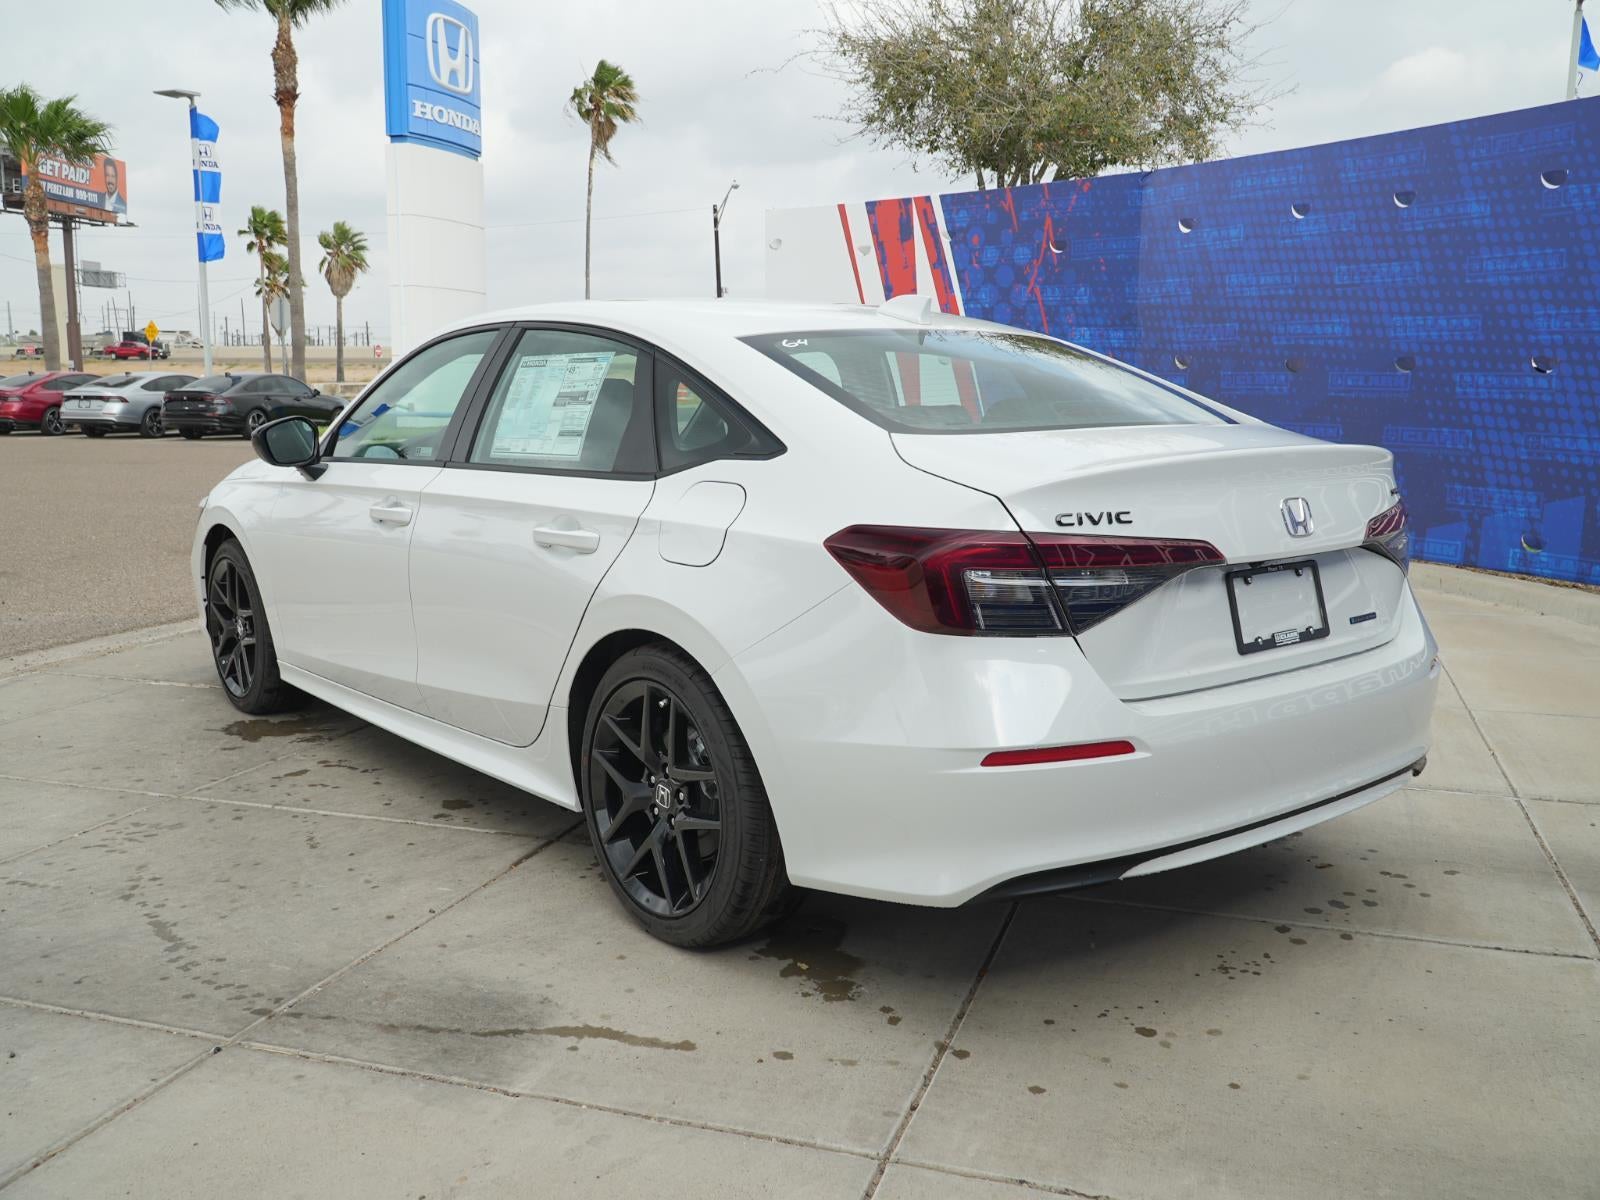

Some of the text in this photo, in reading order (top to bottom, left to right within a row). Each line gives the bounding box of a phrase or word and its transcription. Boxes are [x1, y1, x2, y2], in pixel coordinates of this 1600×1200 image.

[412, 100, 480, 136] HONDA
[39, 158, 90, 185] GET PAID!
[1055, 511, 1133, 526] CIVIC
